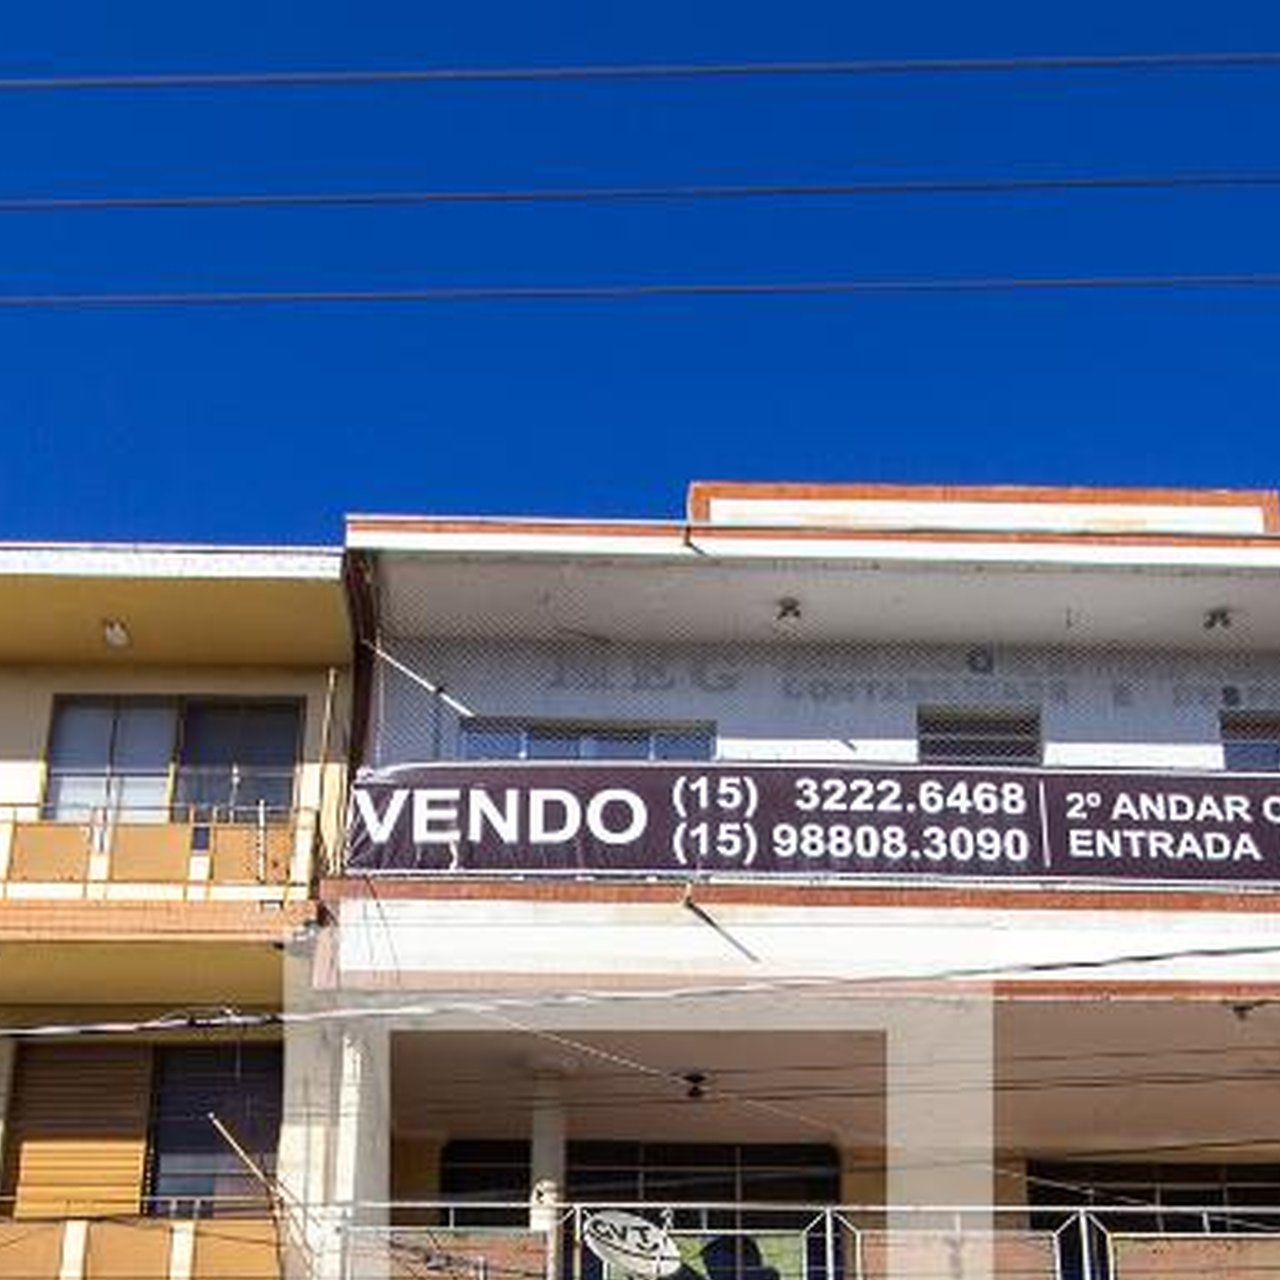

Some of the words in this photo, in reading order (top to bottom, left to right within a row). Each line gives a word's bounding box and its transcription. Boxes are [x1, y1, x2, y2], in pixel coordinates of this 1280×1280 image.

[673, 776, 760, 816] (15)
[796, 777, 1029, 816] 3222.6468
[1111, 794, 1254, 824] ANDAR
[353, 788, 649, 846] VENDO
[673, 822, 760, 867] (15)
[773, 824, 1031, 863] 98808.3090
[1068, 830, 1263, 861] ENTRADA
